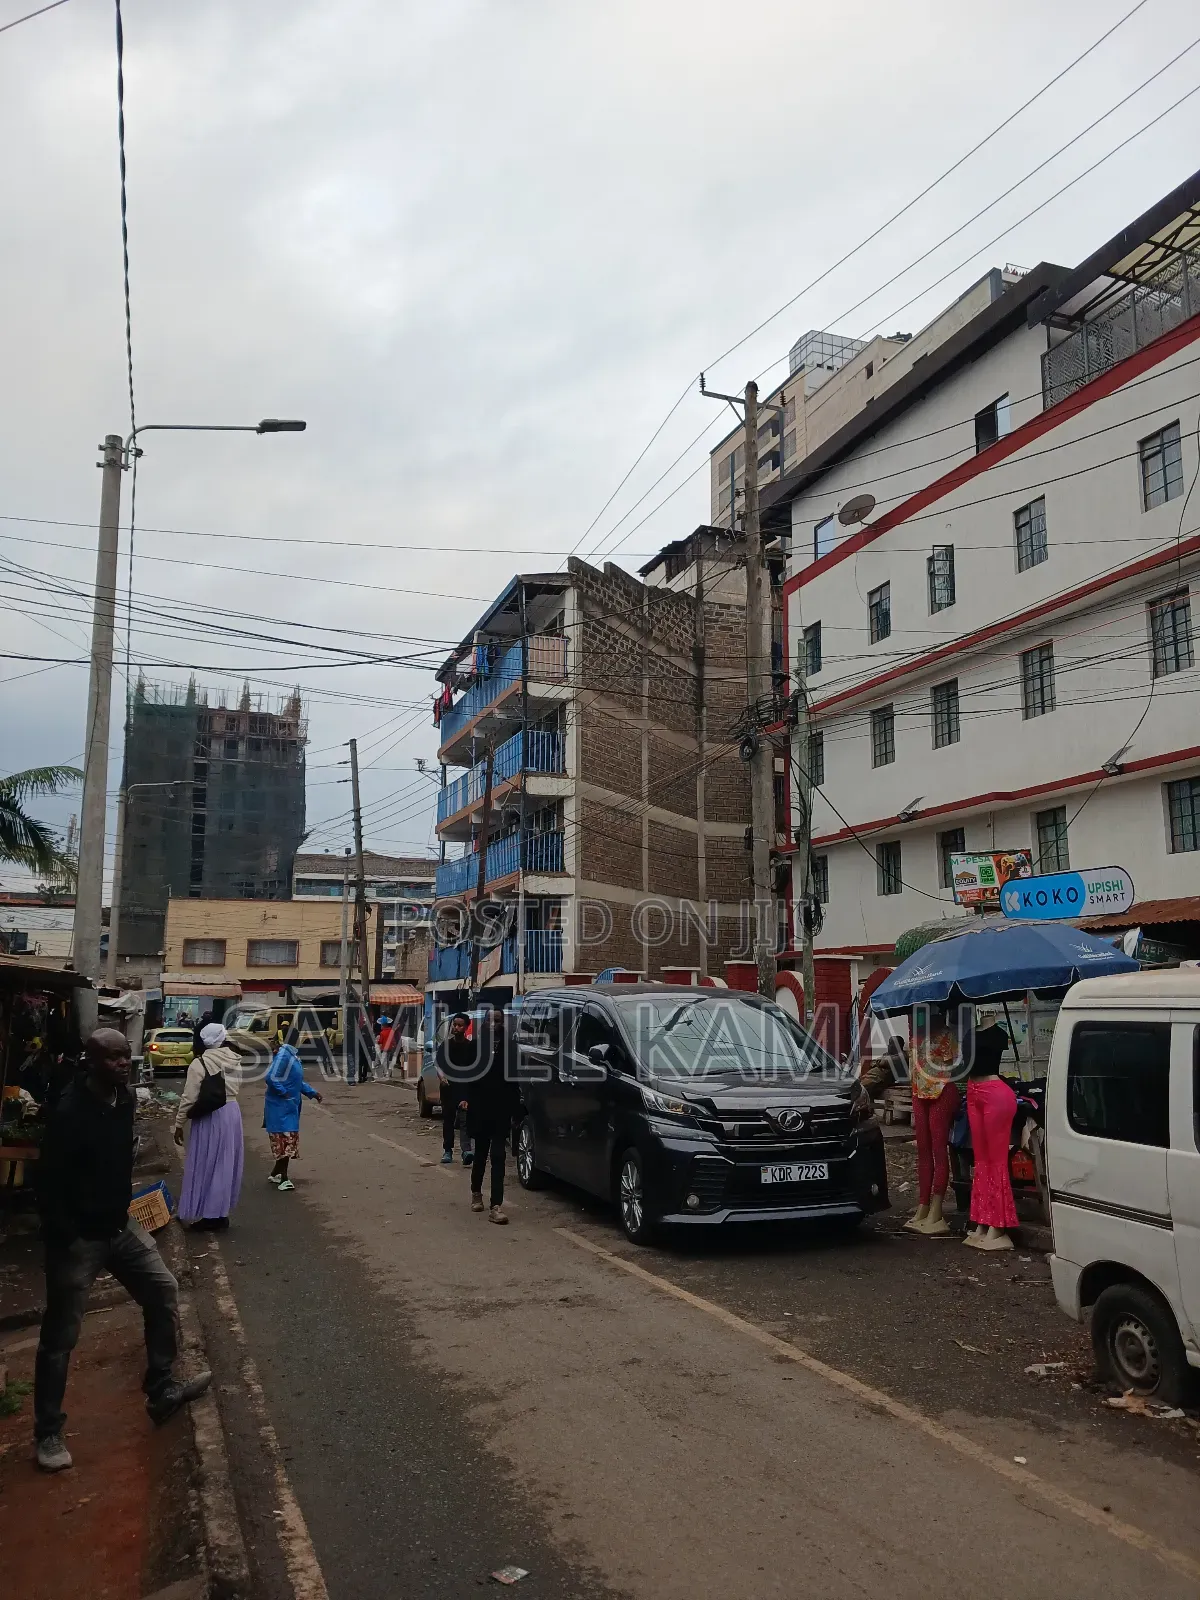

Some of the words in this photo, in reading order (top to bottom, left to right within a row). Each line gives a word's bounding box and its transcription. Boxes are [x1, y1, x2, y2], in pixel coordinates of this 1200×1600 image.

[1087, 879, 1124, 894] UPISHI
[1022, 886, 1079, 907] KOKO
[1089, 892, 1126, 905] SMART
[771, 1166, 793, 1182] KDR
[797, 1165, 826, 1180] 722S
